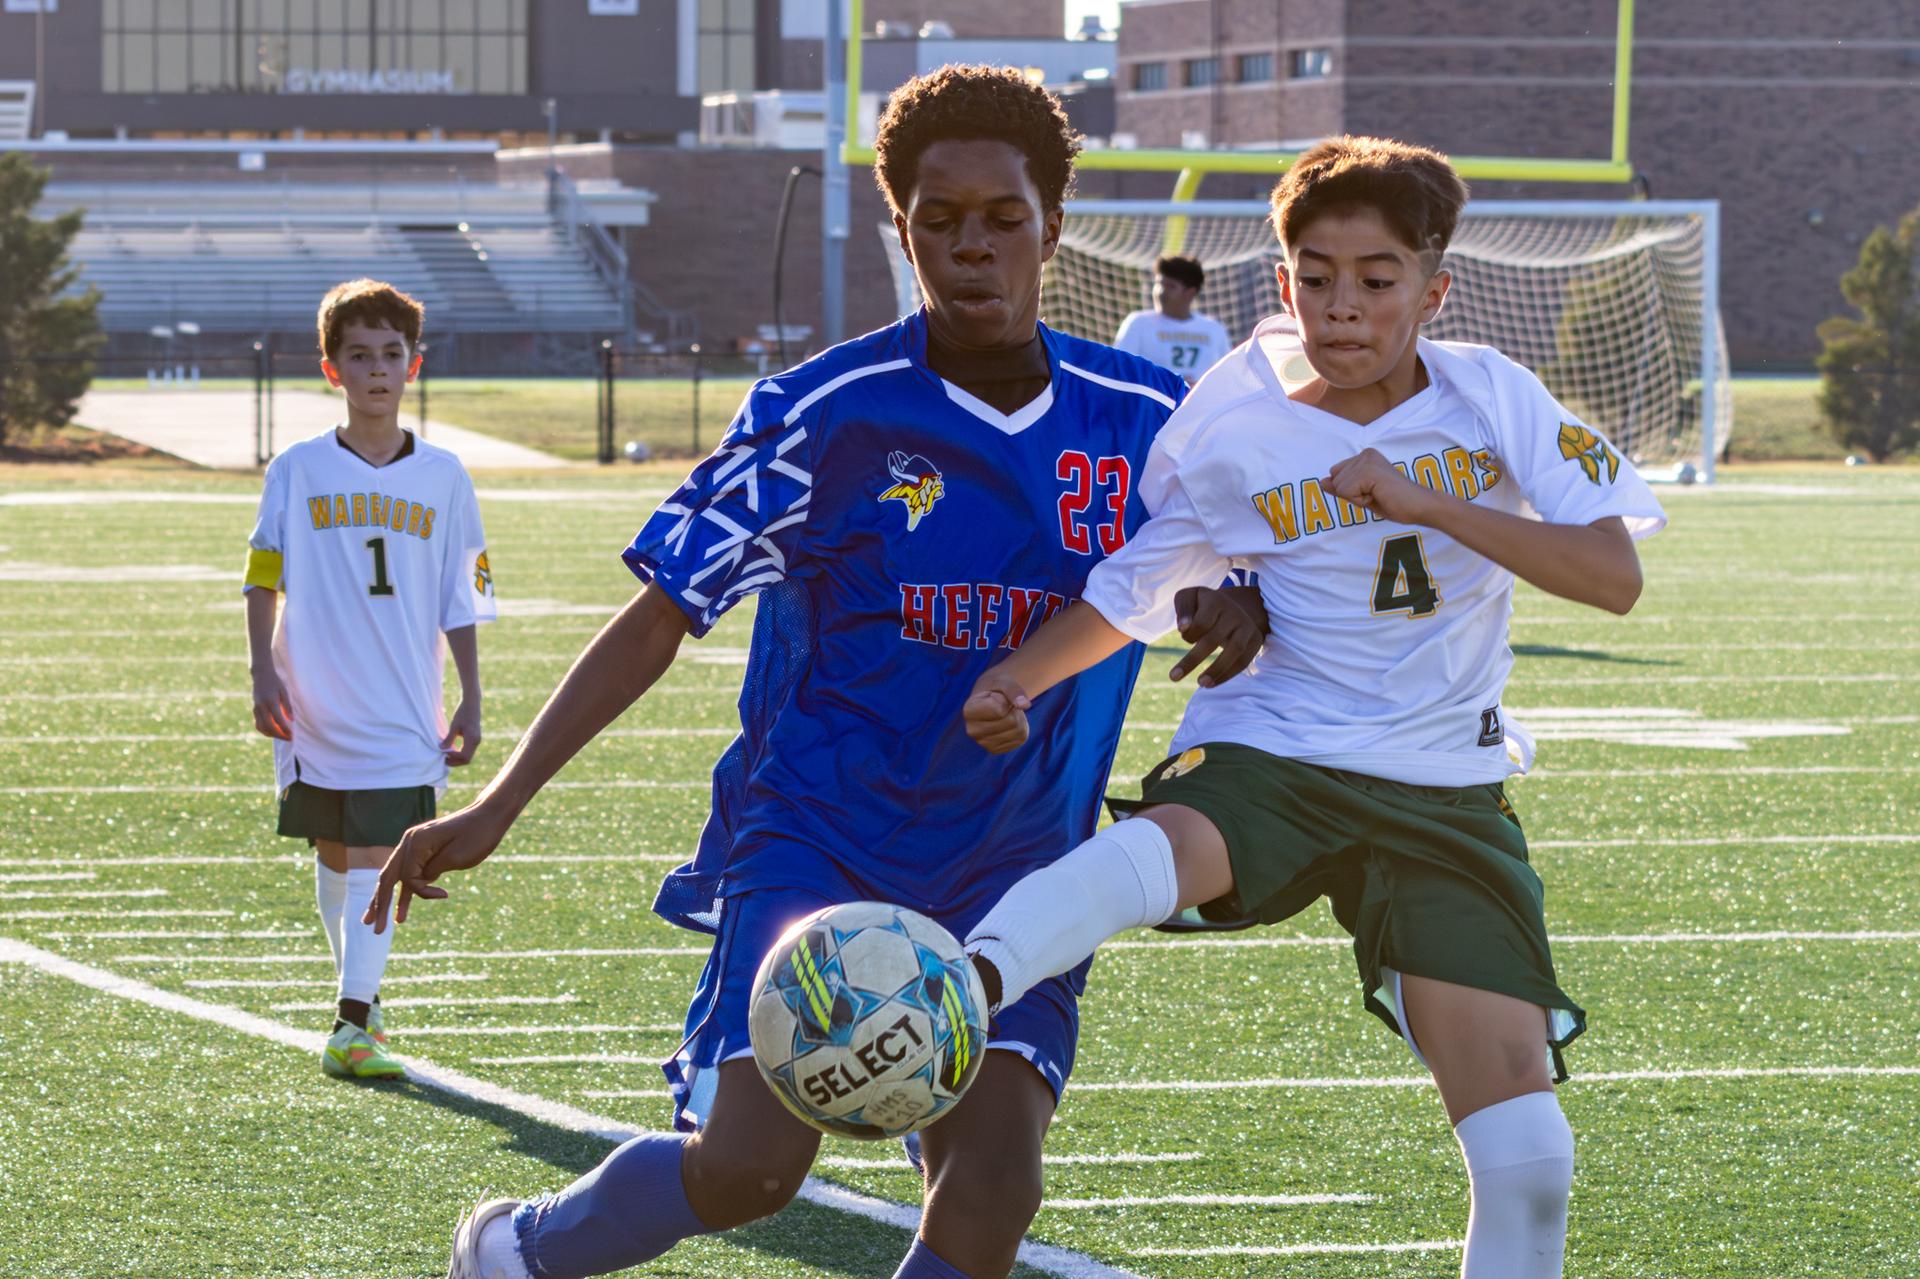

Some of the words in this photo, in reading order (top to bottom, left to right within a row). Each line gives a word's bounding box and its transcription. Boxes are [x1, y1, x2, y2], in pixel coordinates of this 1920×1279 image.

[287, 69, 454, 94] GYMNASIUM
[1171, 346, 1200, 367] 27
[307, 492, 436, 540] WARRIORS
[1056, 450, 1131, 556] 23
[1252, 446, 1501, 544] WAORS
[365, 536, 395, 597] 1
[1370, 531, 1444, 618] 4
[900, 583, 1081, 650] HEFN
[803, 1013, 923, 1106] SELECT
